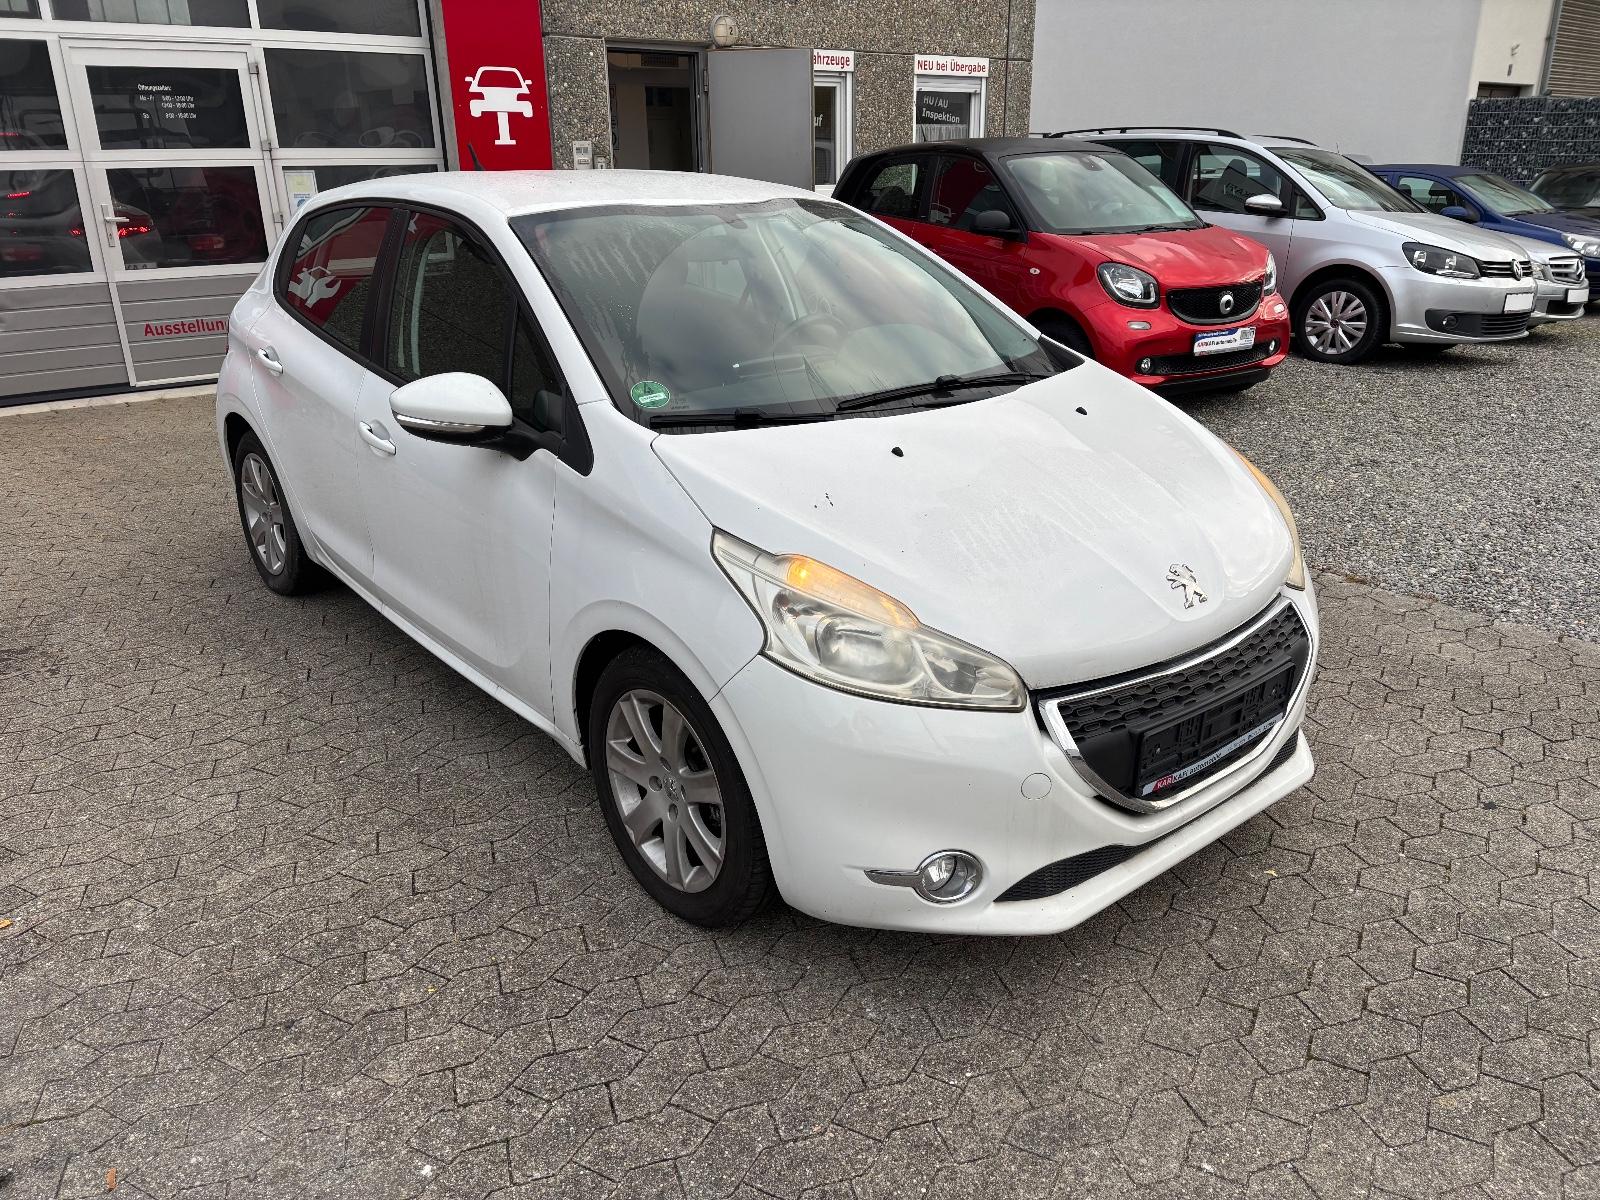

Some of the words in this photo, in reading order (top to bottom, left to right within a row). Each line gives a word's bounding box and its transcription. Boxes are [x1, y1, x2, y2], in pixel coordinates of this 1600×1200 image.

[917, 59, 934, 71] NEU
[936, 60, 948, 72] bei
[950, 58, 986, 75] Übergabe
[923, 94, 949, 109] HU/AU
[921, 108, 960, 124] Inspektion
[144, 319, 227, 337] Ausstellun
